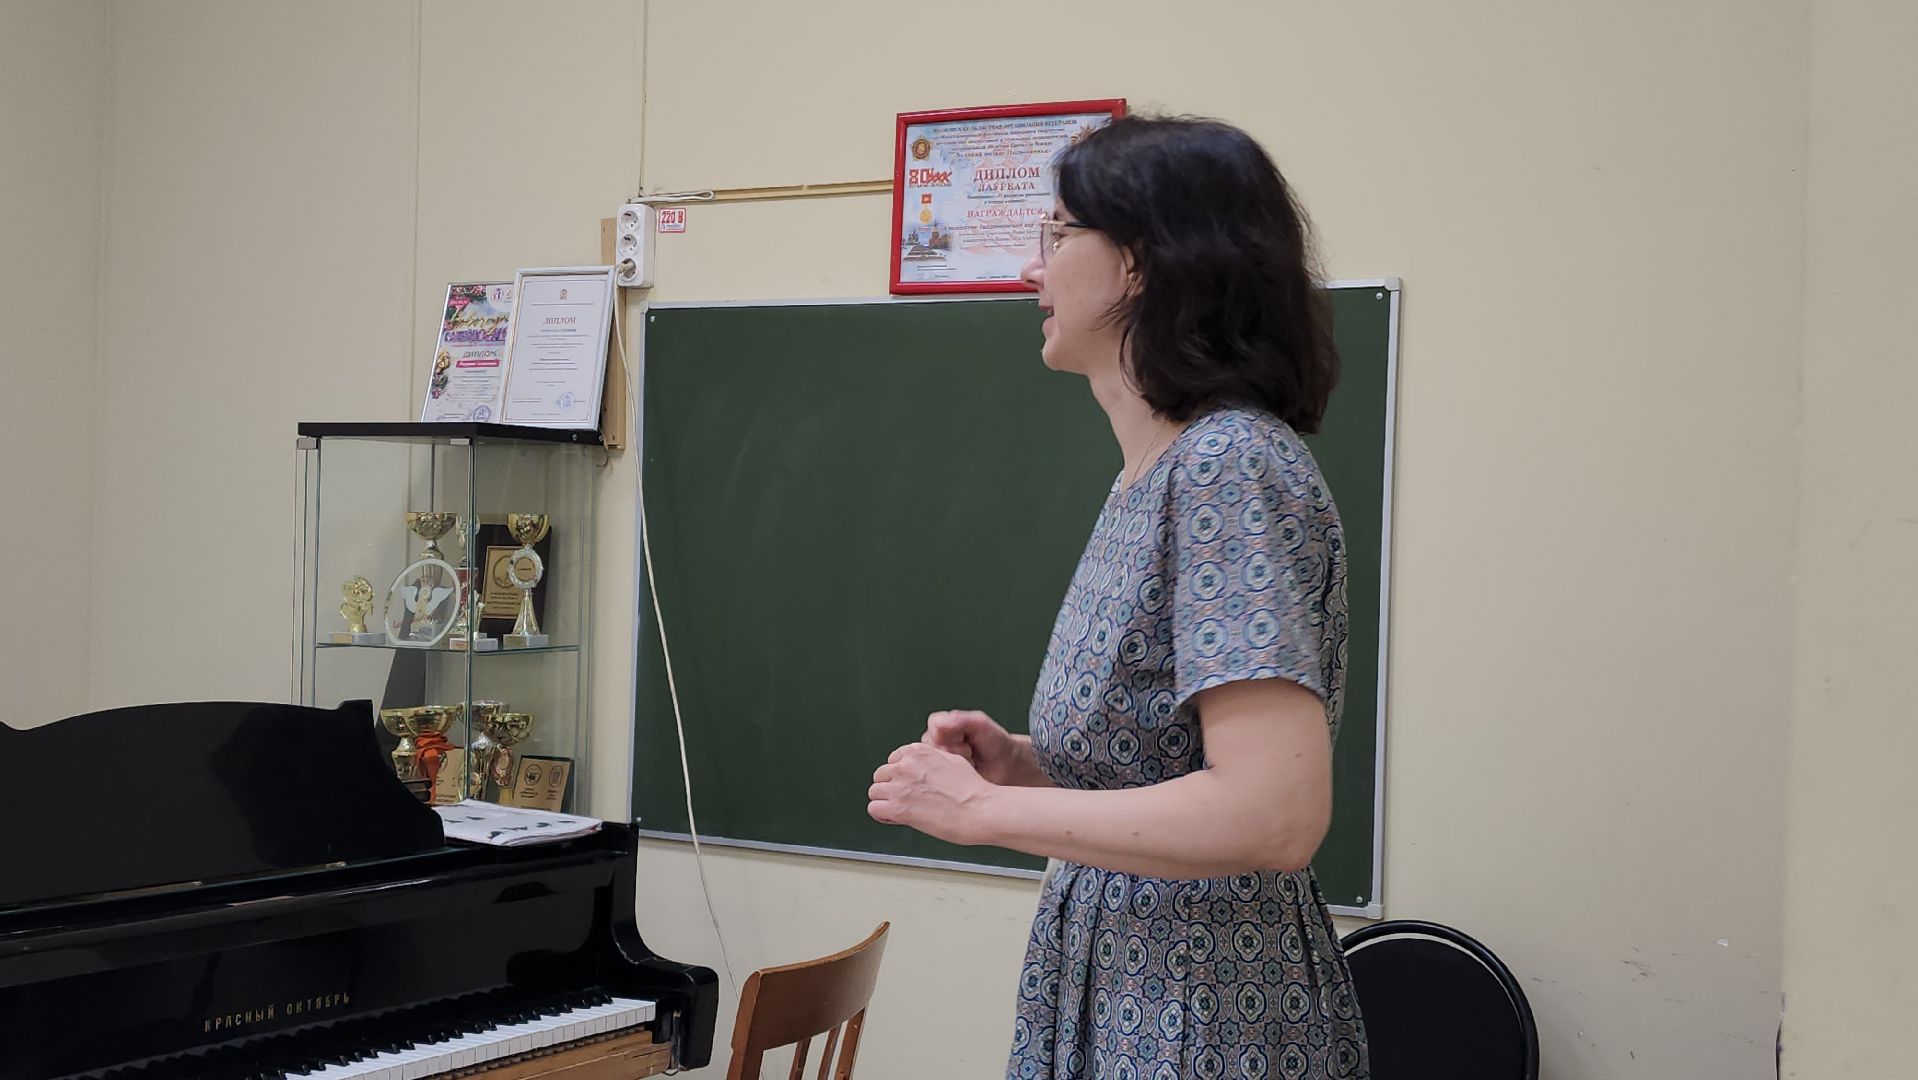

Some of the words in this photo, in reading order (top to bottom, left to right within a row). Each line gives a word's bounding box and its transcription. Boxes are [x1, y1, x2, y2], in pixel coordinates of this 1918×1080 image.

[974, 166, 1040, 182] ДИПЛОМ
[978, 181, 1036, 192] ЛАУРЕАТА
[661, 210, 675, 223] 220
[967, 207, 1043, 218] НАГРАЖДАЕТСЯ
[542, 316, 576, 325] ДИПЛОМ
[204, 1004, 275, 1032] КРАСНЫЙ
[286, 992, 350, 1015] ОКТЯБРЬ
